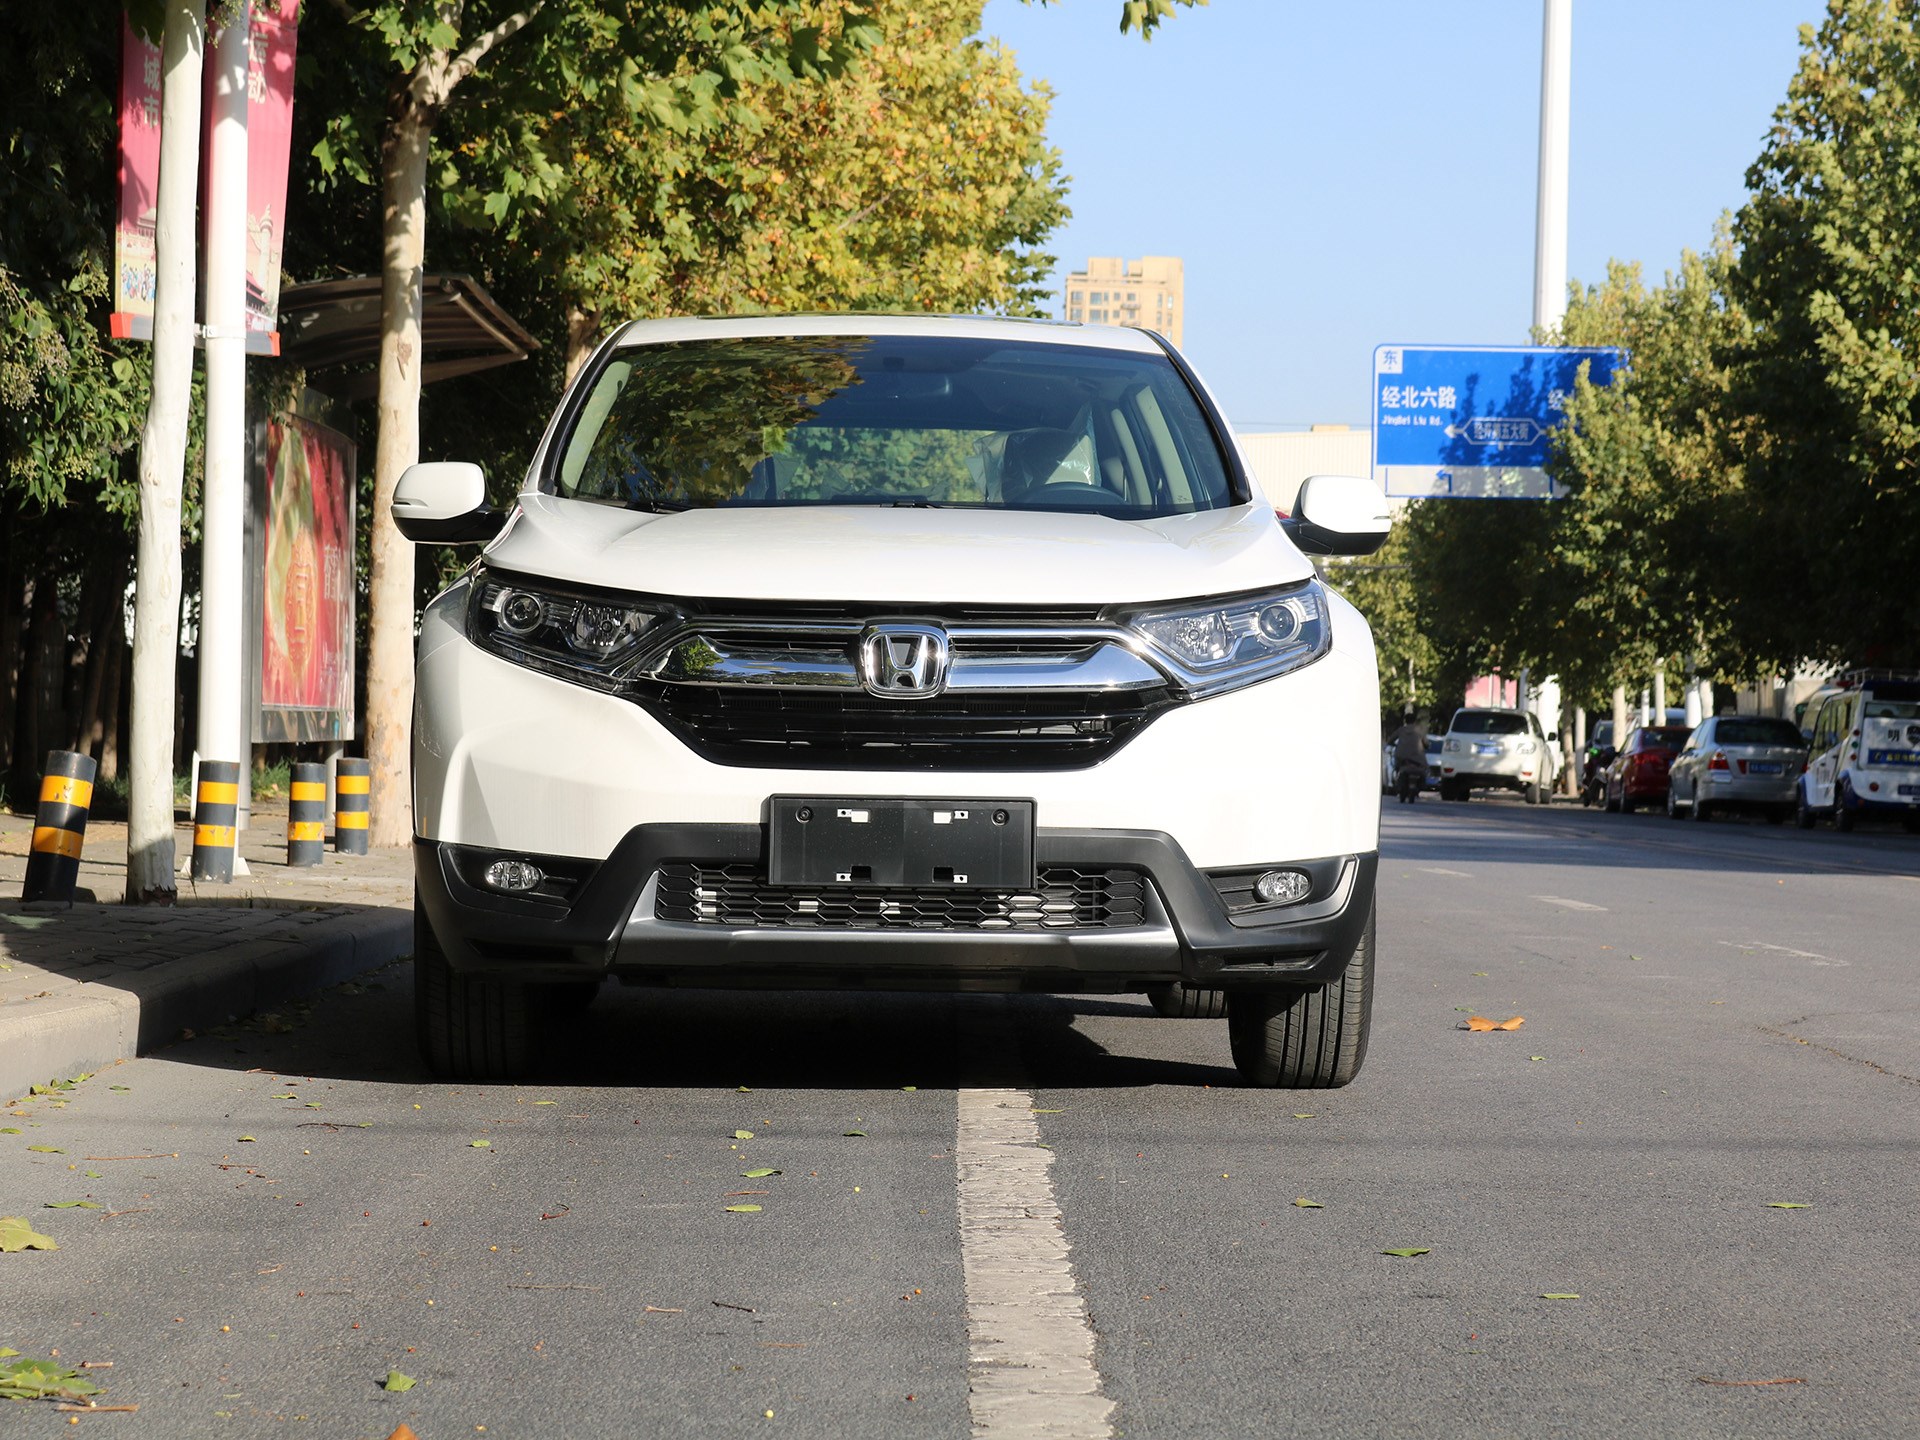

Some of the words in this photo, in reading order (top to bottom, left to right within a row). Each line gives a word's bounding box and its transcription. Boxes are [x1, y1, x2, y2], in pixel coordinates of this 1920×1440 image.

[1383, 350, 1398, 365] 东
[1381, 385, 1457, 410] 经北六路
